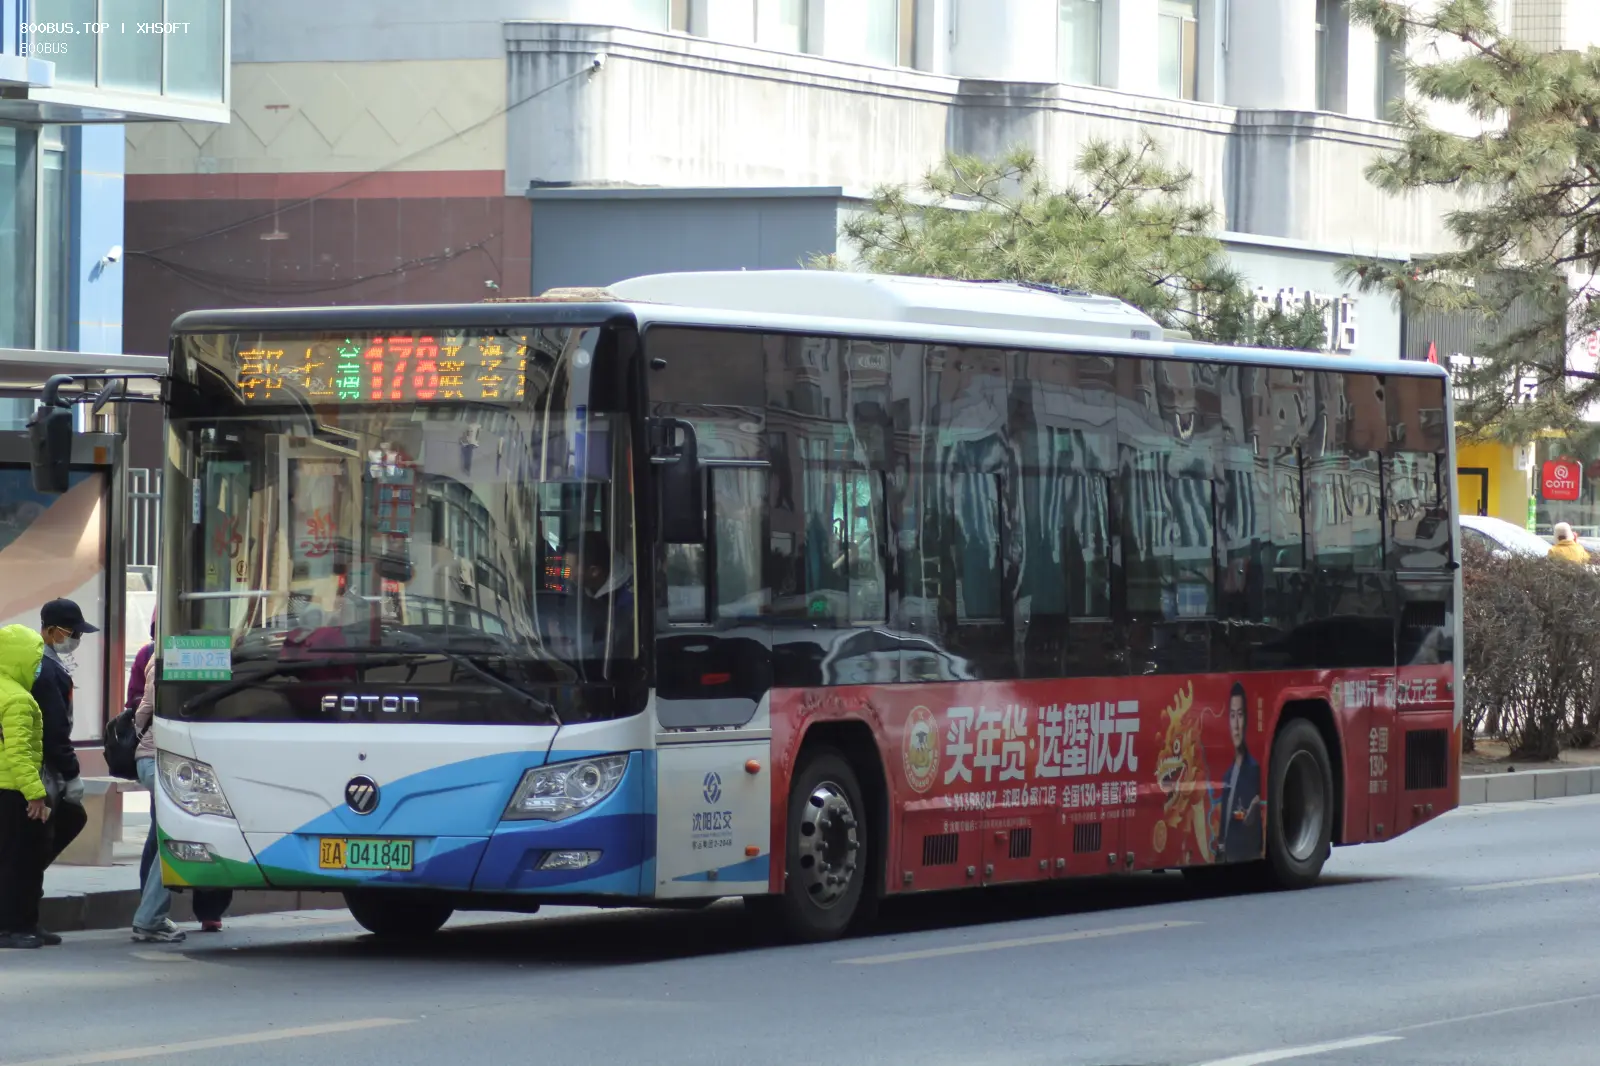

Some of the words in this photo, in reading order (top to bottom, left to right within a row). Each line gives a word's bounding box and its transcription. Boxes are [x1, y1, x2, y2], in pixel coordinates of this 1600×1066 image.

[364, 336, 438, 400] 178
[1545, 480, 1574, 488] COTTI
[321, 695, 420, 712] FOTON
[692, 811, 732, 831] 沈阳公交
